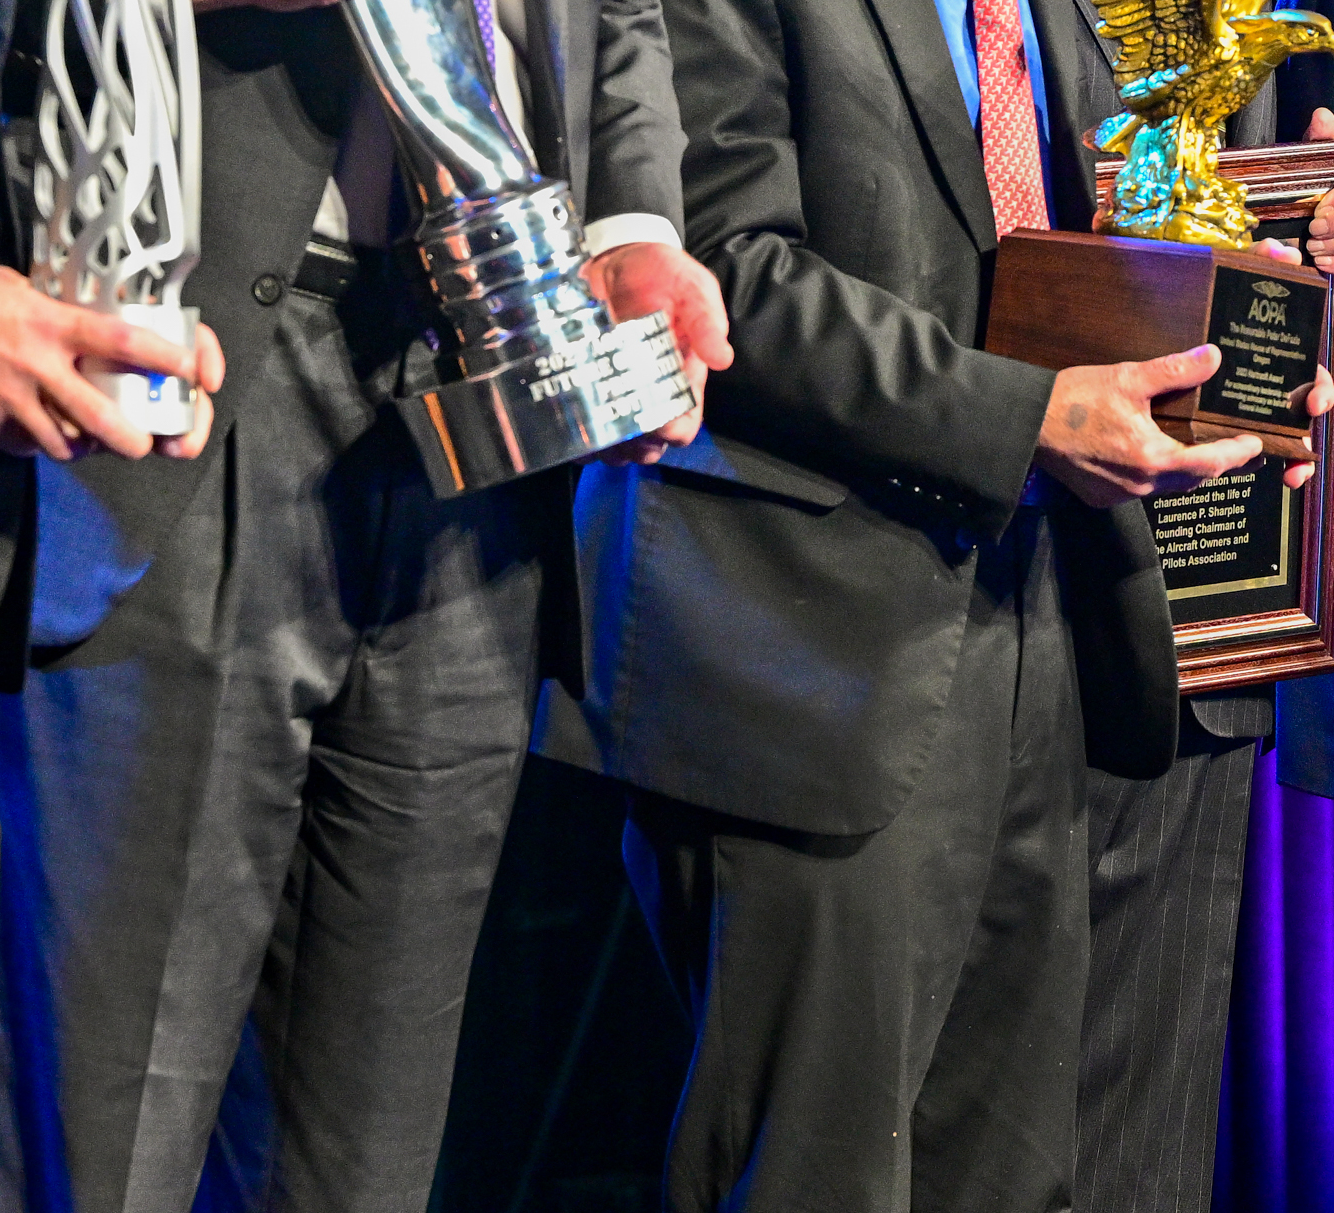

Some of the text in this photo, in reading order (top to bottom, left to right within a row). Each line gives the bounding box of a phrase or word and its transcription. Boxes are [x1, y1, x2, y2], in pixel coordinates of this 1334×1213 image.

[1248, 297, 1287, 326] AOPA
[1231, 473, 1256, 485] which
[1153, 486, 1252, 509] characterized the life of
[1158, 503, 1245, 524] Laurence P. Sharples
[1155, 517, 1247, 540] founding Chairman of
[1166, 539, 1199, 554] Aircraft
[1199, 536, 1232, 550] Owners
[1233, 532, 1250, 545] and
[1162, 550, 1238, 570] Pilots Association
